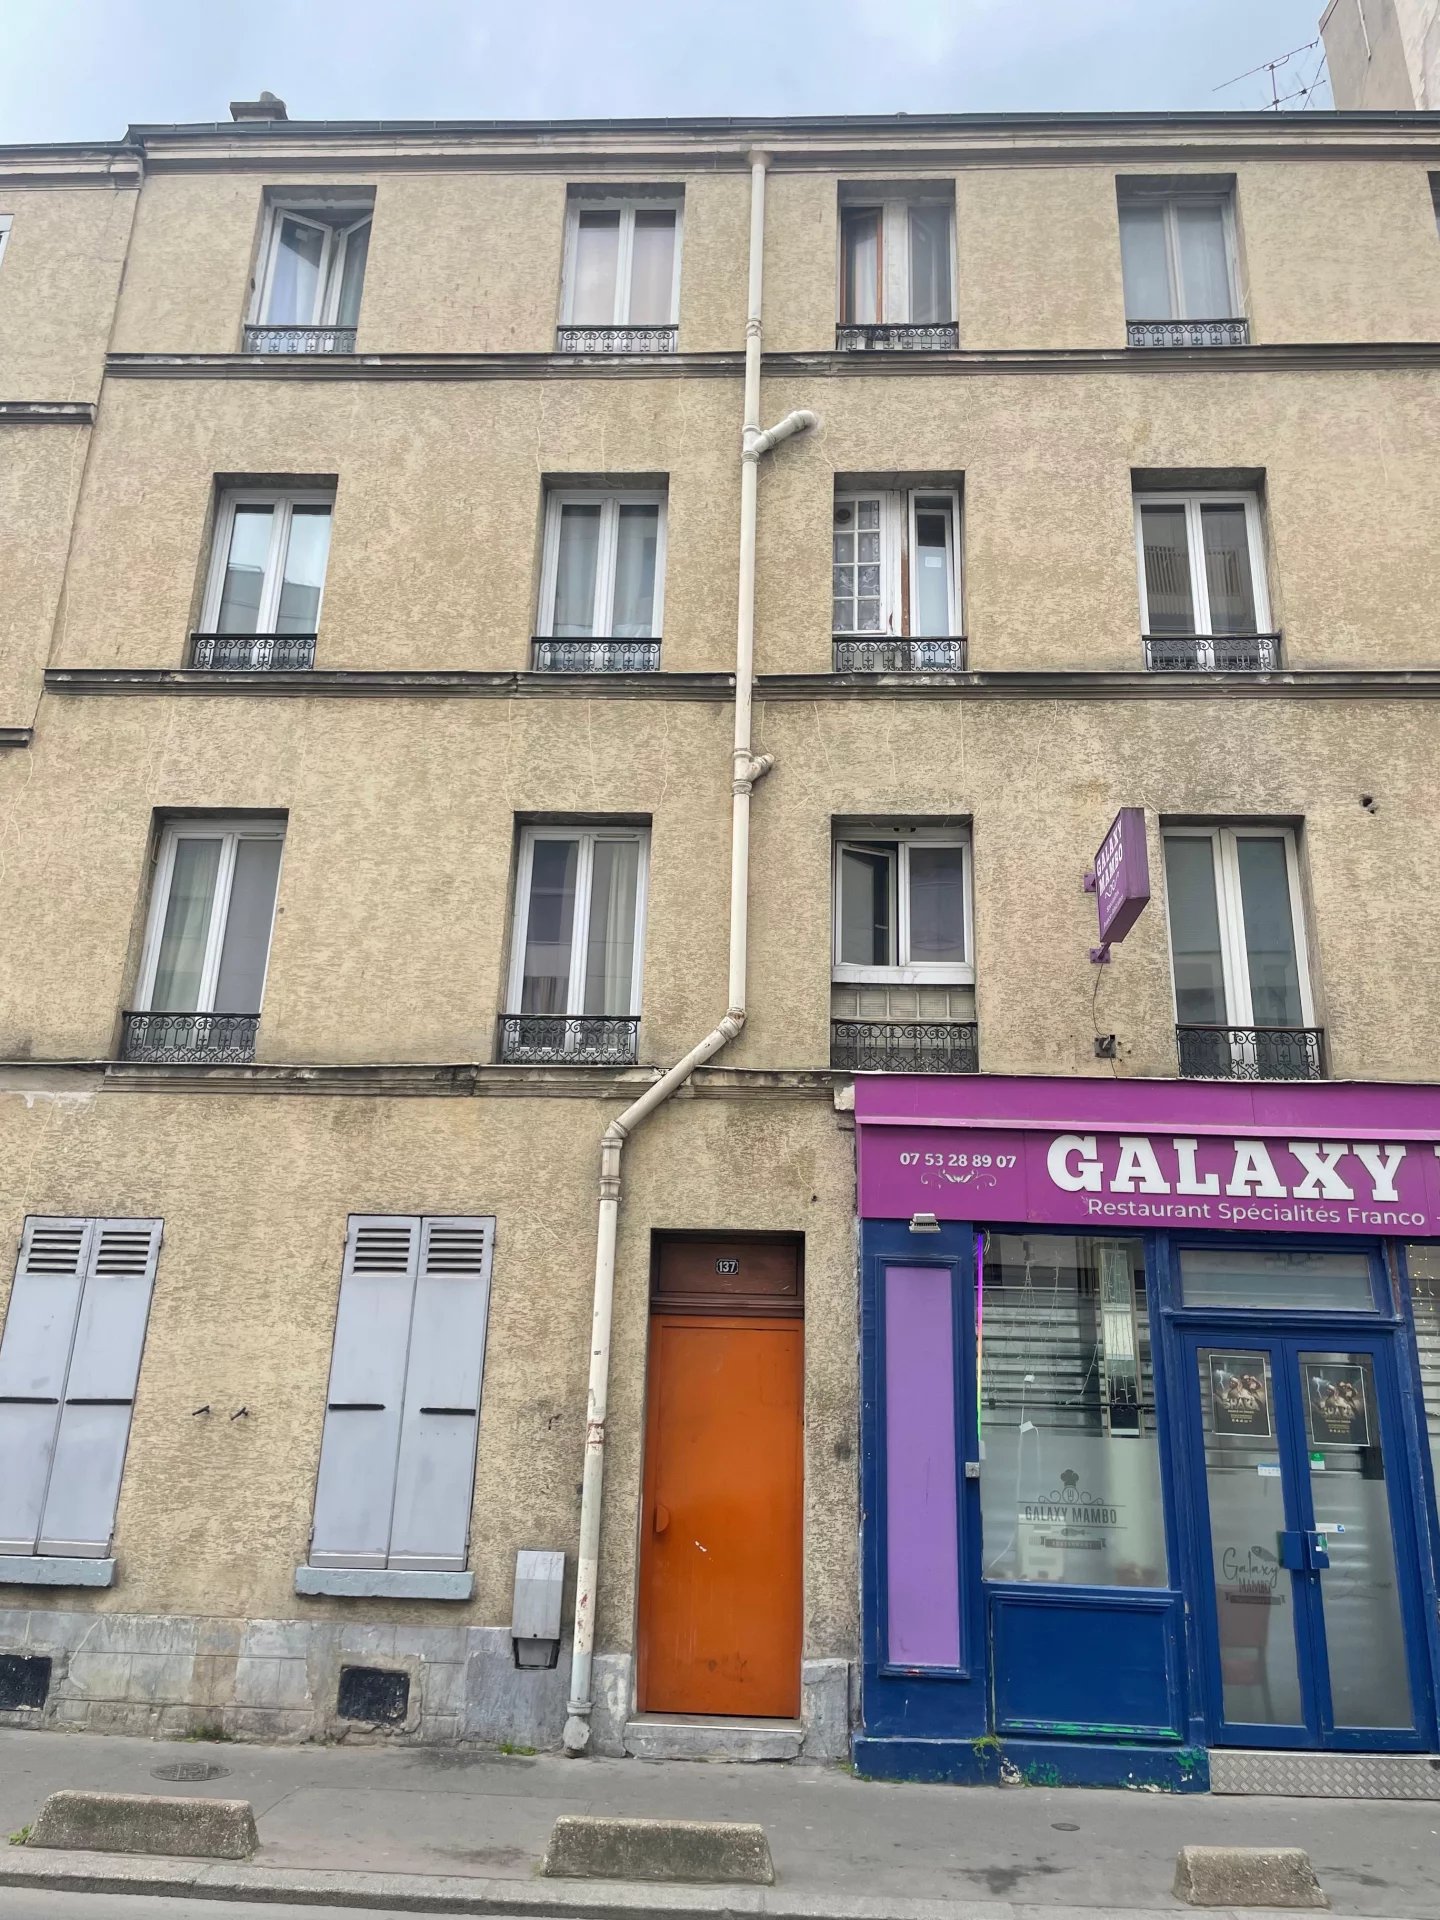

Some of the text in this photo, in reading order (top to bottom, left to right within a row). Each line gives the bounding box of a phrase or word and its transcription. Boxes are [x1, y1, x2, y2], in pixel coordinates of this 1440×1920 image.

[1096, 819, 1123, 877] GALAXY
[1099, 842, 1123, 897] MAMBO
[899, 1152, 1017, 1168] 07 53 28 89 07
[1046, 1134, 1407, 1202] GALAXY
[1087, 1199, 1426, 1226] Restaurant Spécialités Franco
[719, 1261, 736, 1272] 137
[1024, 1505, 1118, 1524] GALAXY MAMBO
[1222, 1547, 1279, 1589] Galaxy
